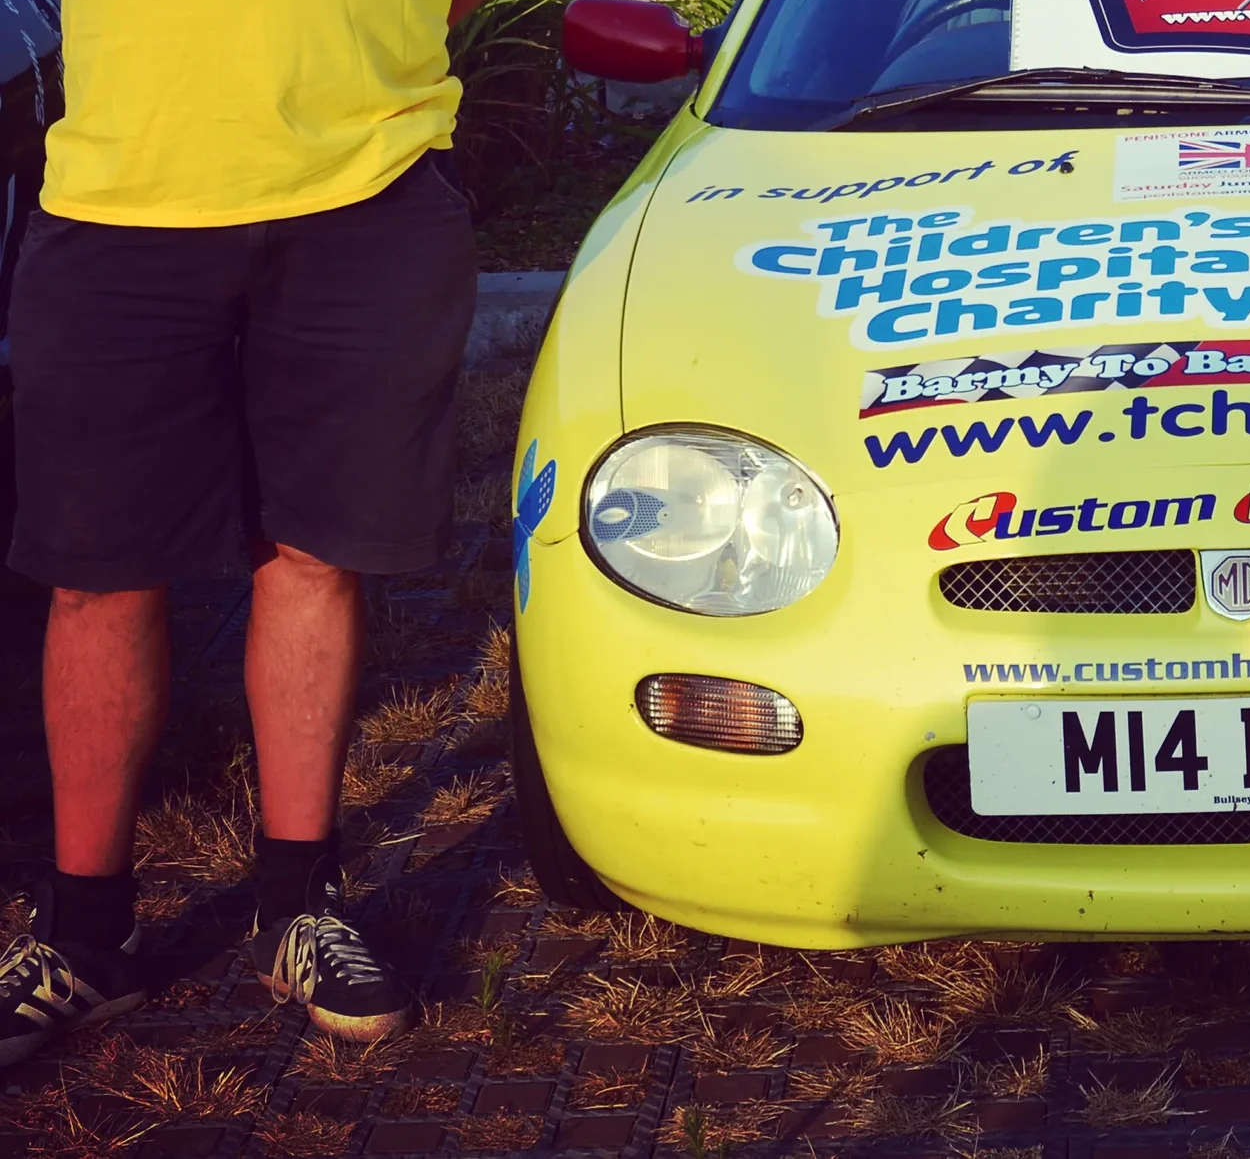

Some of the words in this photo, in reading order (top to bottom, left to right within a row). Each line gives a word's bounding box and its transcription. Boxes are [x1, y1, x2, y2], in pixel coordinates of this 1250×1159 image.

[1125, 131, 1209, 142] PENISTONE
[685, 186, 744, 204] in
[758, 160, 996, 204] support
[1008, 150, 1080, 176] of
[1121, 181, 1211, 192] Saturday
[817, 211, 961, 241] The
[880, 353, 1078, 404] Barmy
[1091, 350, 1170, 379] To
[928, 491, 1215, 551] Custom
